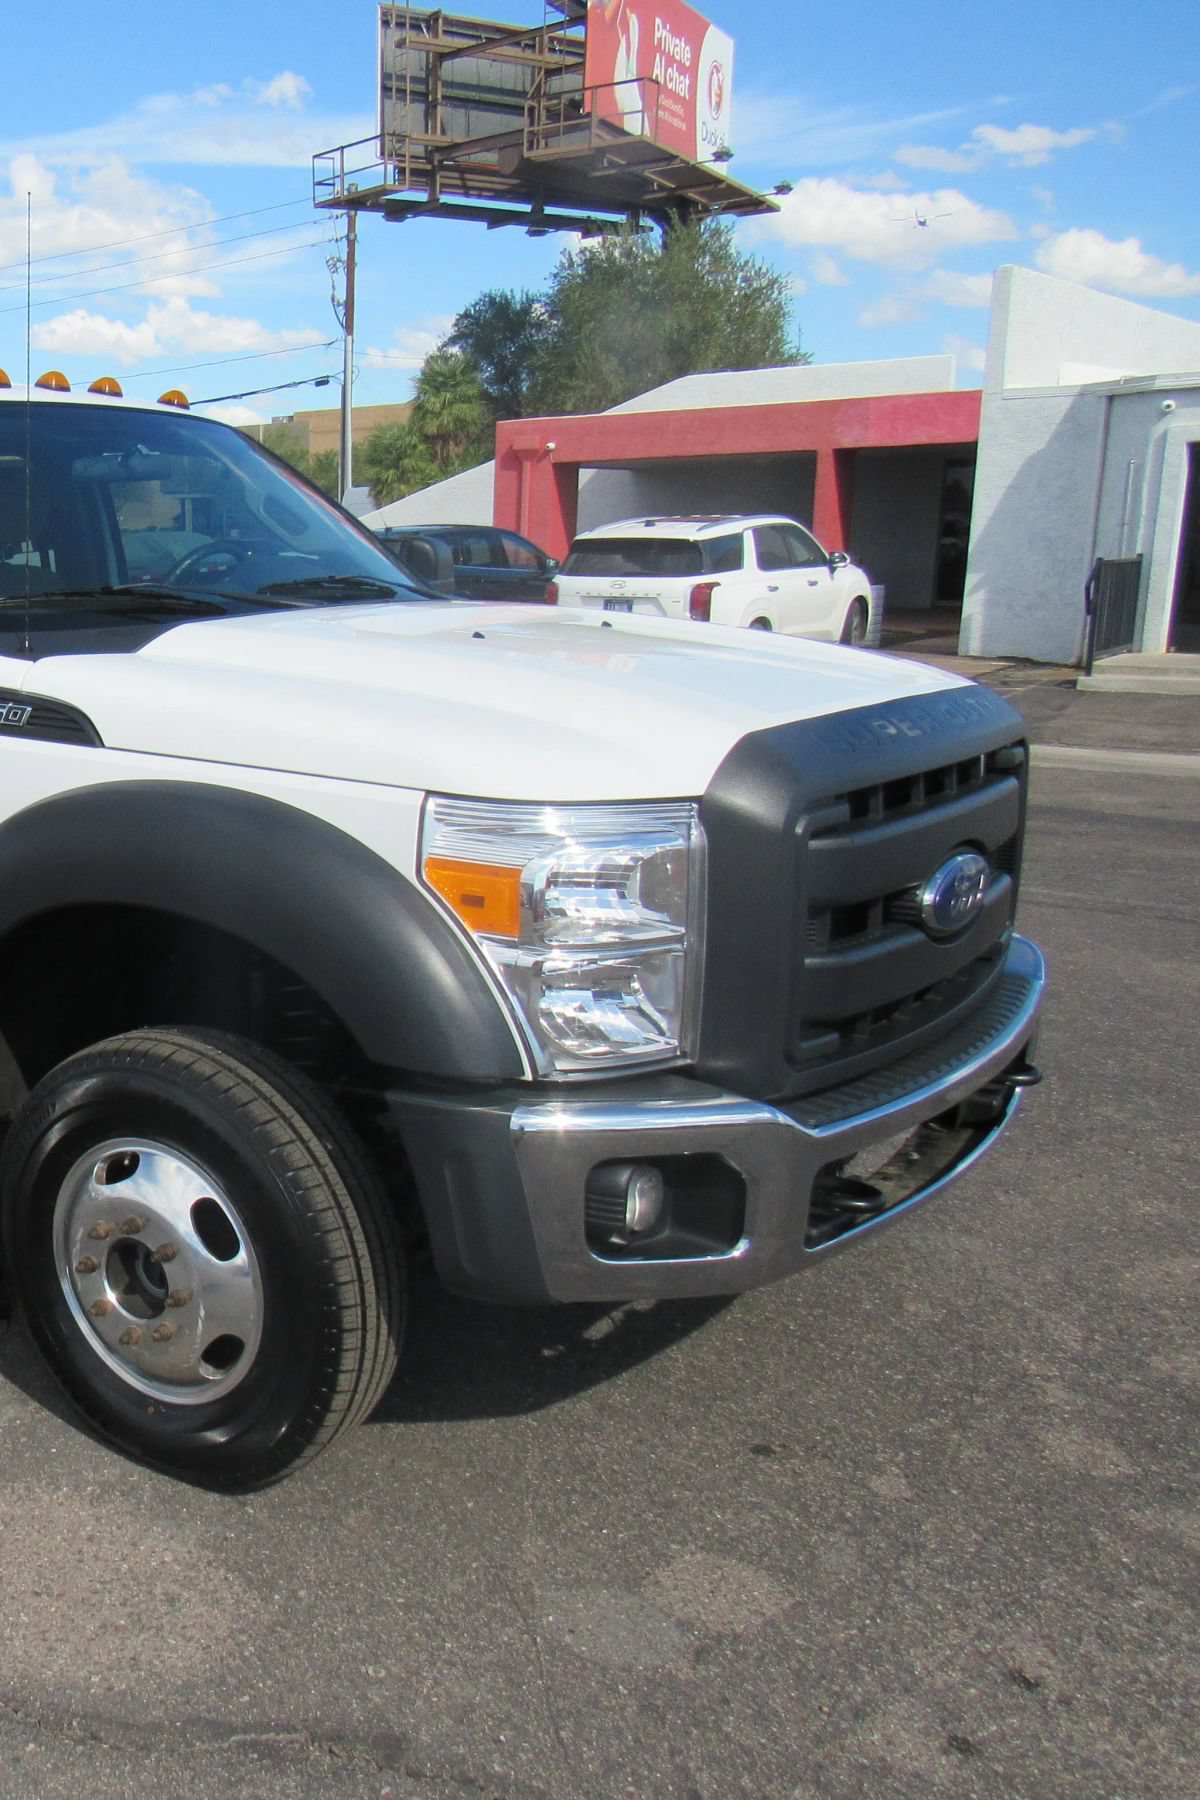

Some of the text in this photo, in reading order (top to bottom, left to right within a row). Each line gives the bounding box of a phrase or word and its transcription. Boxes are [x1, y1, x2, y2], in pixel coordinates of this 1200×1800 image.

[654, 17, 691, 67] Private
[652, 53, 690, 100] AI chat
